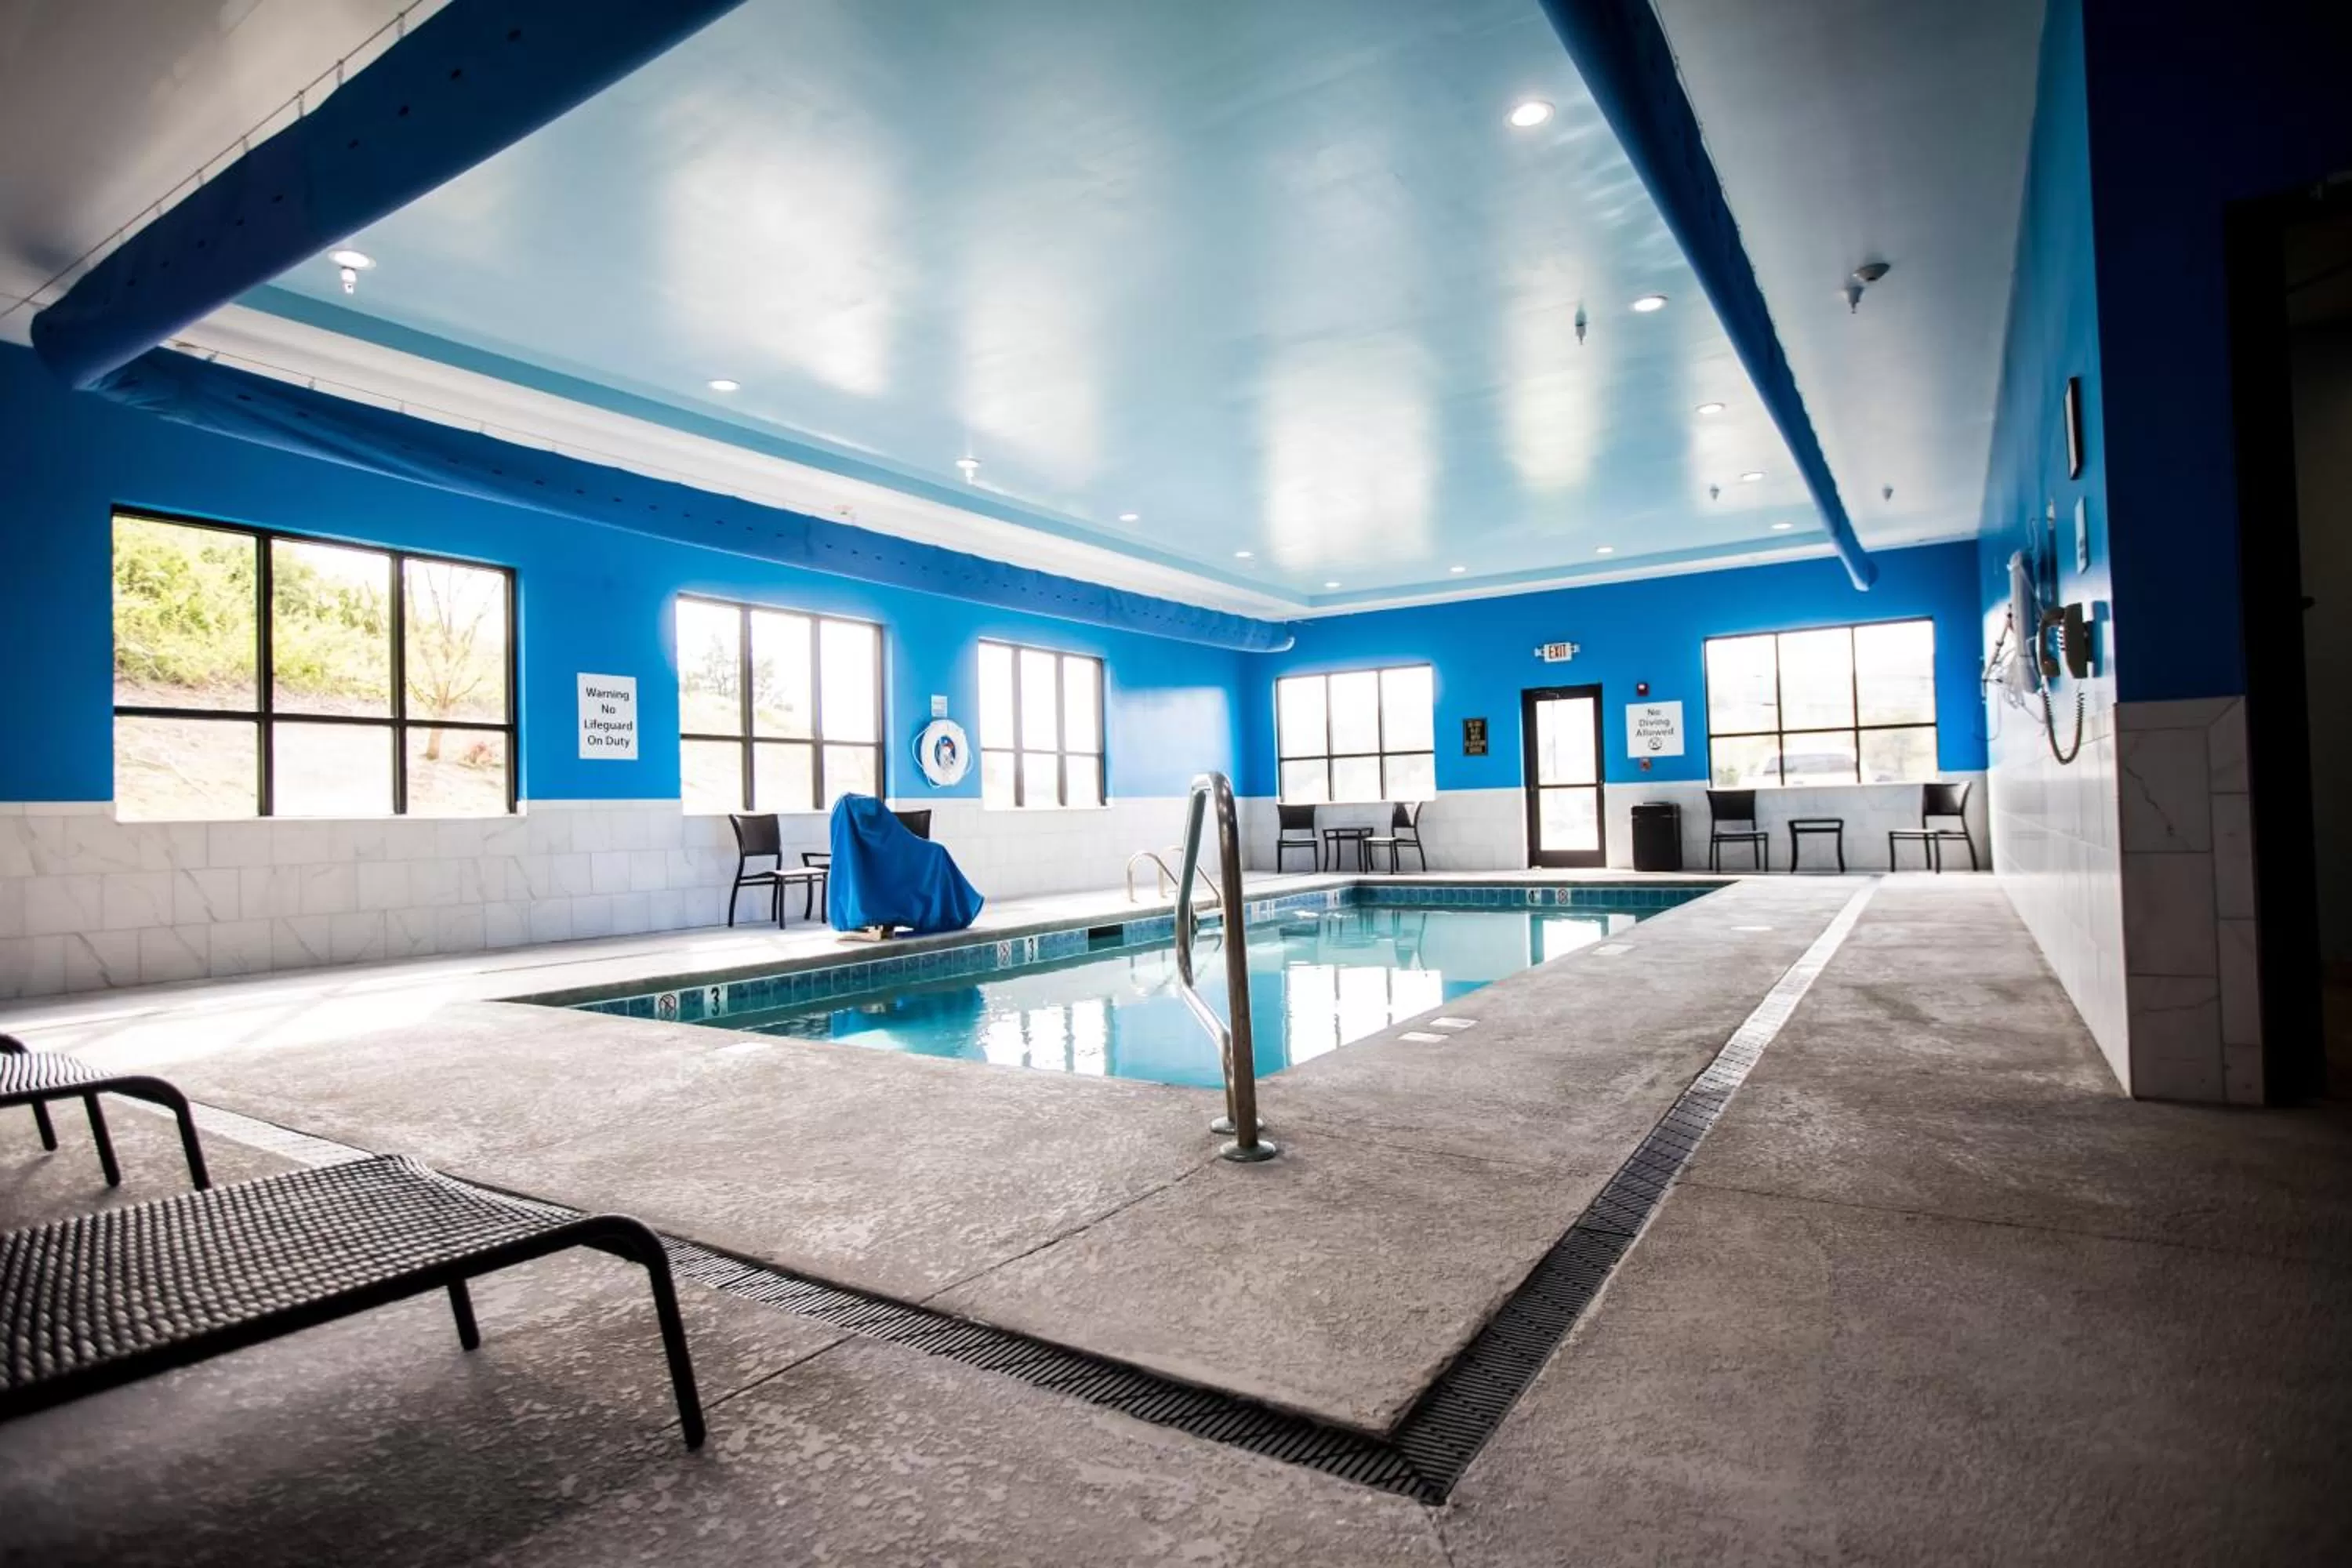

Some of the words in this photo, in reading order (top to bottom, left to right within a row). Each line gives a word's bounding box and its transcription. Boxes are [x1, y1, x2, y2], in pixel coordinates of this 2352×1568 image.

[1548, 644, 1566, 659] EXIT
[586, 687, 630, 702] Warning
[601, 704, 615, 714] No
[584, 719, 633, 732] Lifeguard
[1639, 719, 1671, 728] Diving
[1636, 728, 1675, 737] Allowed
[587, 735, 603, 746] On
[606, 735, 631, 749] Duty
